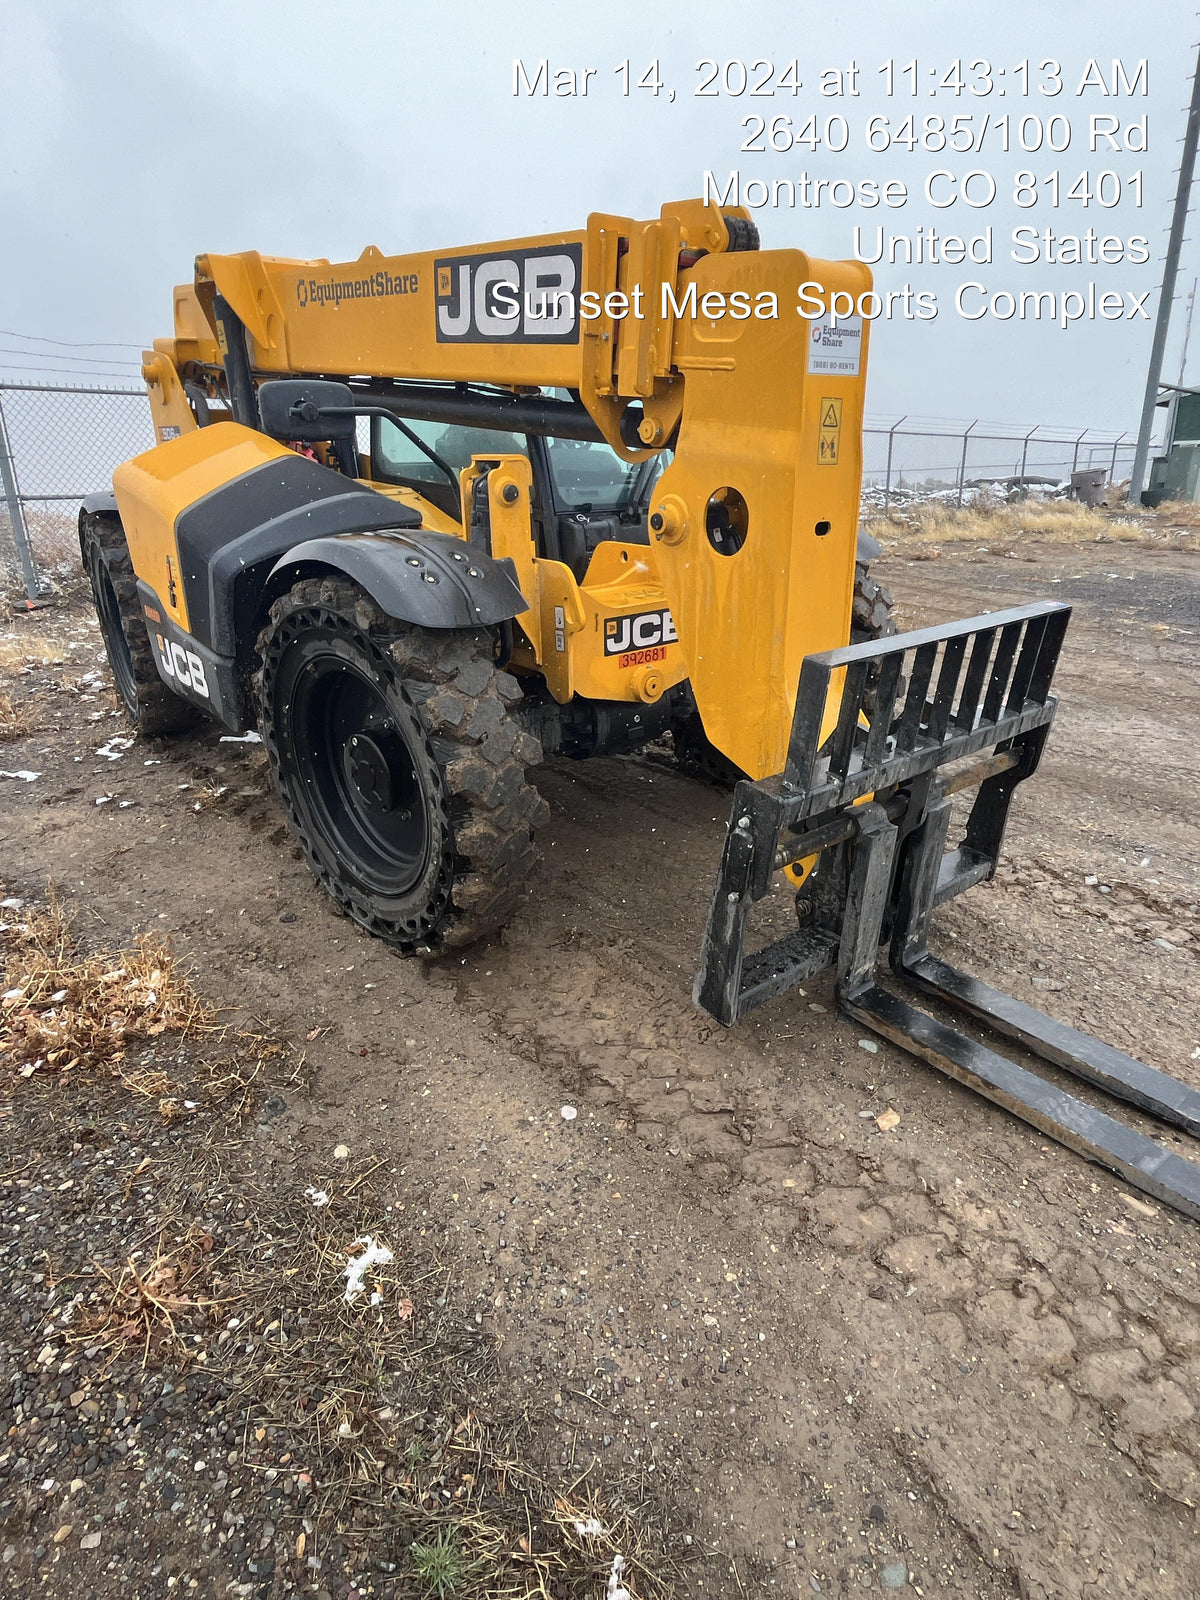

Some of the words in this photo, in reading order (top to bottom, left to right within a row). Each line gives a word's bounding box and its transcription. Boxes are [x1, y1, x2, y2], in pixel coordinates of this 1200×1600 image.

[308, 270, 419, 306] EquipmentShare
[438, 255, 576, 336] JCB
[822, 325, 861, 338] Equipment
[822, 337, 843, 347] Share
[161, 637, 210, 698] JCB
[622, 647, 665, 668] 392681
